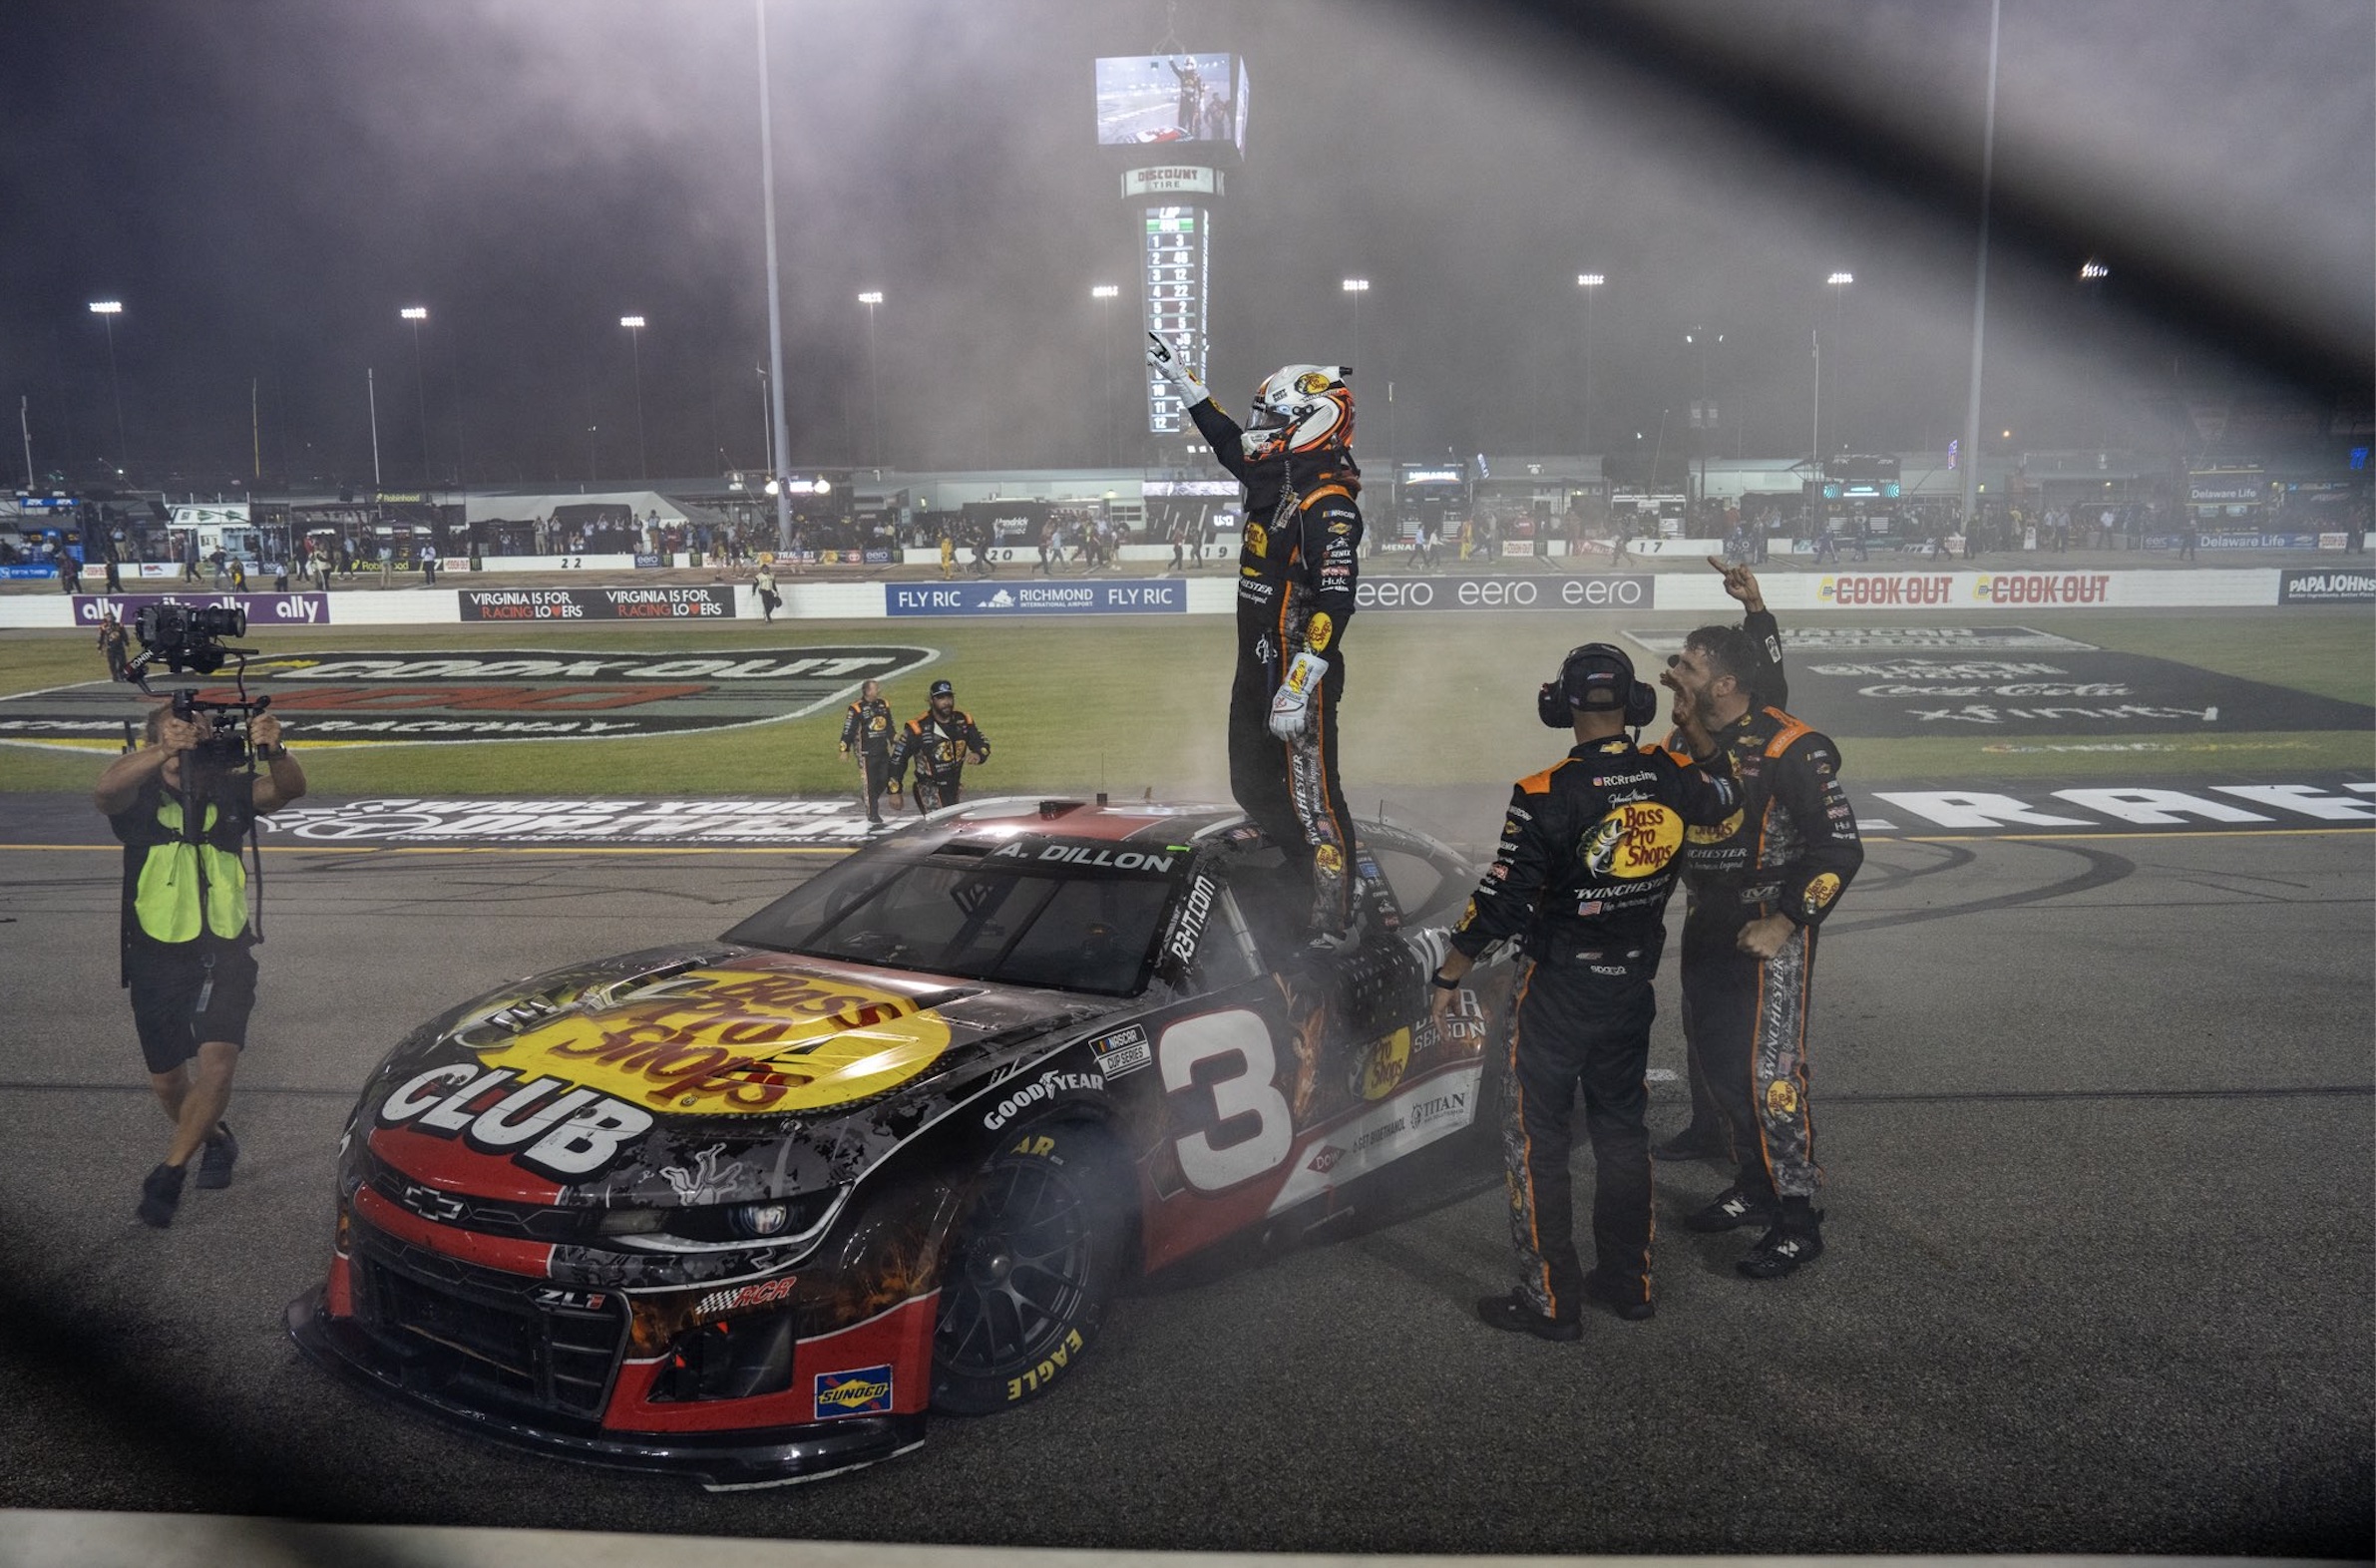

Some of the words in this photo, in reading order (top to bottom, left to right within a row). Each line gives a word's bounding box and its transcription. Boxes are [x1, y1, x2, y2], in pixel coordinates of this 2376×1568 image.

[1138, 169, 1198, 182] DISCOUNT
[1152, 235, 1160, 247] 1
[1175, 233, 1184, 246] 3
[1152, 252, 1160, 264] 2
[1152, 269, 1161, 280] 3
[1174, 268, 1187, 280] 12
[1152, 285, 1162, 297] 4
[1173, 285, 1189, 296] 22
[1153, 301, 1162, 313] 5
[1178, 301, 1187, 313] 2
[1179, 318, 1187, 329] 5
[1154, 401, 1165, 413] 11
[1154, 417, 1166, 429] 12
[2191, 489, 2235, 499] Delaware
[2238, 489, 2256, 498] Life
[1332, 510, 1356, 520] NASCAR
[2200, 536, 2258, 548] Delaware
[2261, 536, 2285, 548] Life
[867, 551, 888, 560] eero
[362, 561, 409, 571] Robiood
[1836, 578, 1901, 604] COOK
[1906, 578, 1952, 604] OUT
[1992, 577, 2058, 603] COOK
[2062, 576, 2110, 602] OUT
[2289, 576, 2326, 591] PAPA
[2327, 575, 2376, 591] JOHNS
[471, 592, 529, 605] VIRGINIA
[532, 592, 542, 604] IS
[544, 591, 572, 604] FOR
[606, 590, 666, 603] VIRGINIA
[670, 590, 681, 601] IS
[683, 589, 710, 601] FOR
[900, 591, 931, 607] FLY
[935, 591, 961, 607] RIC
[1020, 588, 1093, 601] RICHMOND
[1108, 589, 1138, 604] FLY
[1143, 588, 1172, 604] RIC
[1356, 583, 1433, 605] eero
[1458, 582, 1537, 604] eero
[1562, 581, 1641, 604] eero
[83, 596, 123, 621] ally
[276, 596, 318, 622] ally
[483, 605, 534, 618] RACING
[619, 604, 670, 616] RACING
[274, 659, 643, 679] COOK
[623, 656, 896, 678] OUT
[296, 718, 639, 732] RACEWAY
[1603, 771, 1658, 786] RCRracing
[395, 801, 645, 814] WHO'S
[642, 801, 856, 814] YOUR
[1624, 807, 1664, 829] Bass
[1626, 828, 1655, 846] Pro
[995, 842, 1028, 858] A.
[1038, 846, 1174, 873] DILLON
[1626, 845, 1673, 868] Shops
[1688, 848, 1748, 859] CHESTER
[1574, 874, 1671, 899] WINCHESTER
[1764, 958, 1784, 1080] WINCHESTER
[1108, 1029, 1137, 1049] NASCAR
[550, 1022, 816, 1110] Shops
[1107, 1052, 1122, 1070] CUP
[1120, 1047, 1144, 1066] SERIES
[1372, 1059, 1403, 1087] Shops
[984, 1070, 1103, 1130] GOODYEAR
[1159, 1008, 1293, 1191] 3
[1423, 1092, 1465, 1116] TITAN
[381, 1063, 654, 1174] CLUB
[535, 1288, 605, 1310] ZL1
[732, 1277, 797, 1308] RCR
[1007, 1328, 1083, 1400] EAGLE
[819, 1383, 889, 1402] SUNOCO
